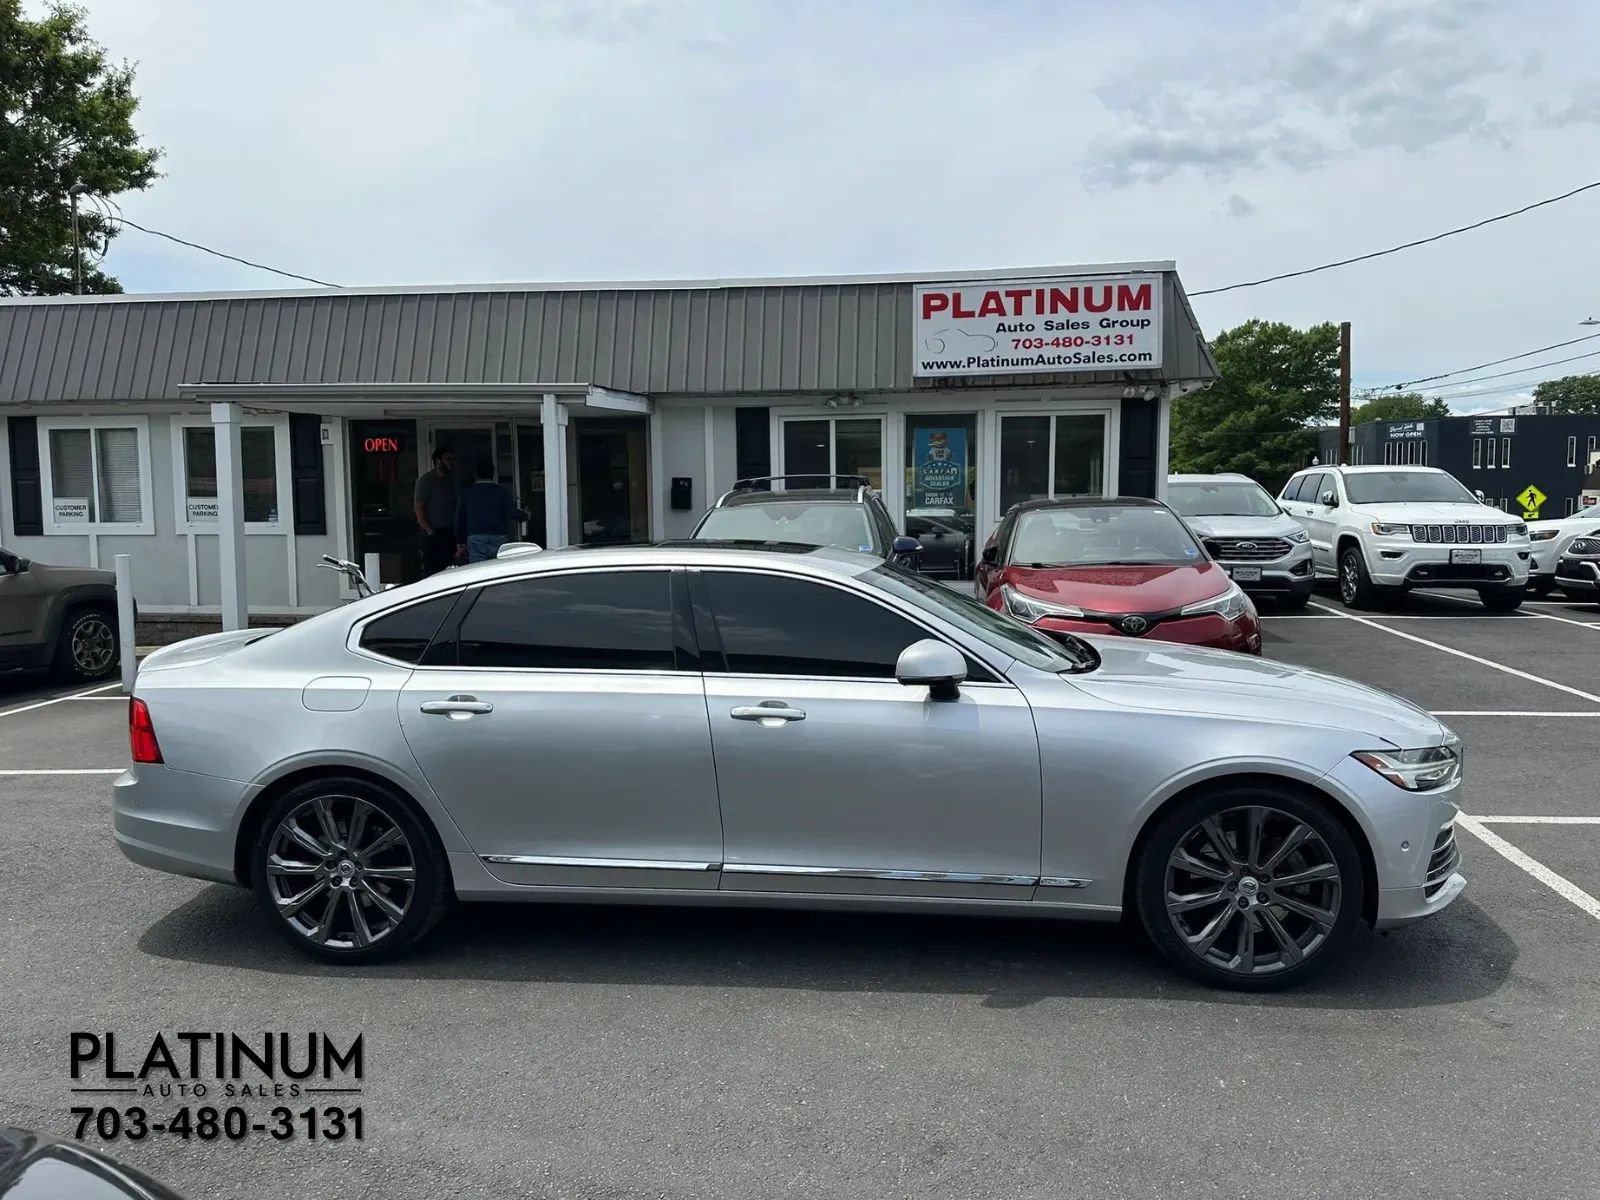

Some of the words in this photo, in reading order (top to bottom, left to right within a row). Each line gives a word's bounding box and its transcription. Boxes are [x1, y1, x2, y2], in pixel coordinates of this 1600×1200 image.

[922, 284, 1152, 320] PLATINUM
[995, 322, 1036, 333] Auto
[1043, 320, 1090, 331] Sales
[1098, 318, 1151, 330] Group
[1011, 334, 1134, 350] 703-480-3131
[922, 351, 1152, 370] www.PlatinumAutoSales.com
[364, 438, 398, 452] OPEN
[925, 497, 954, 505] CARFAX
